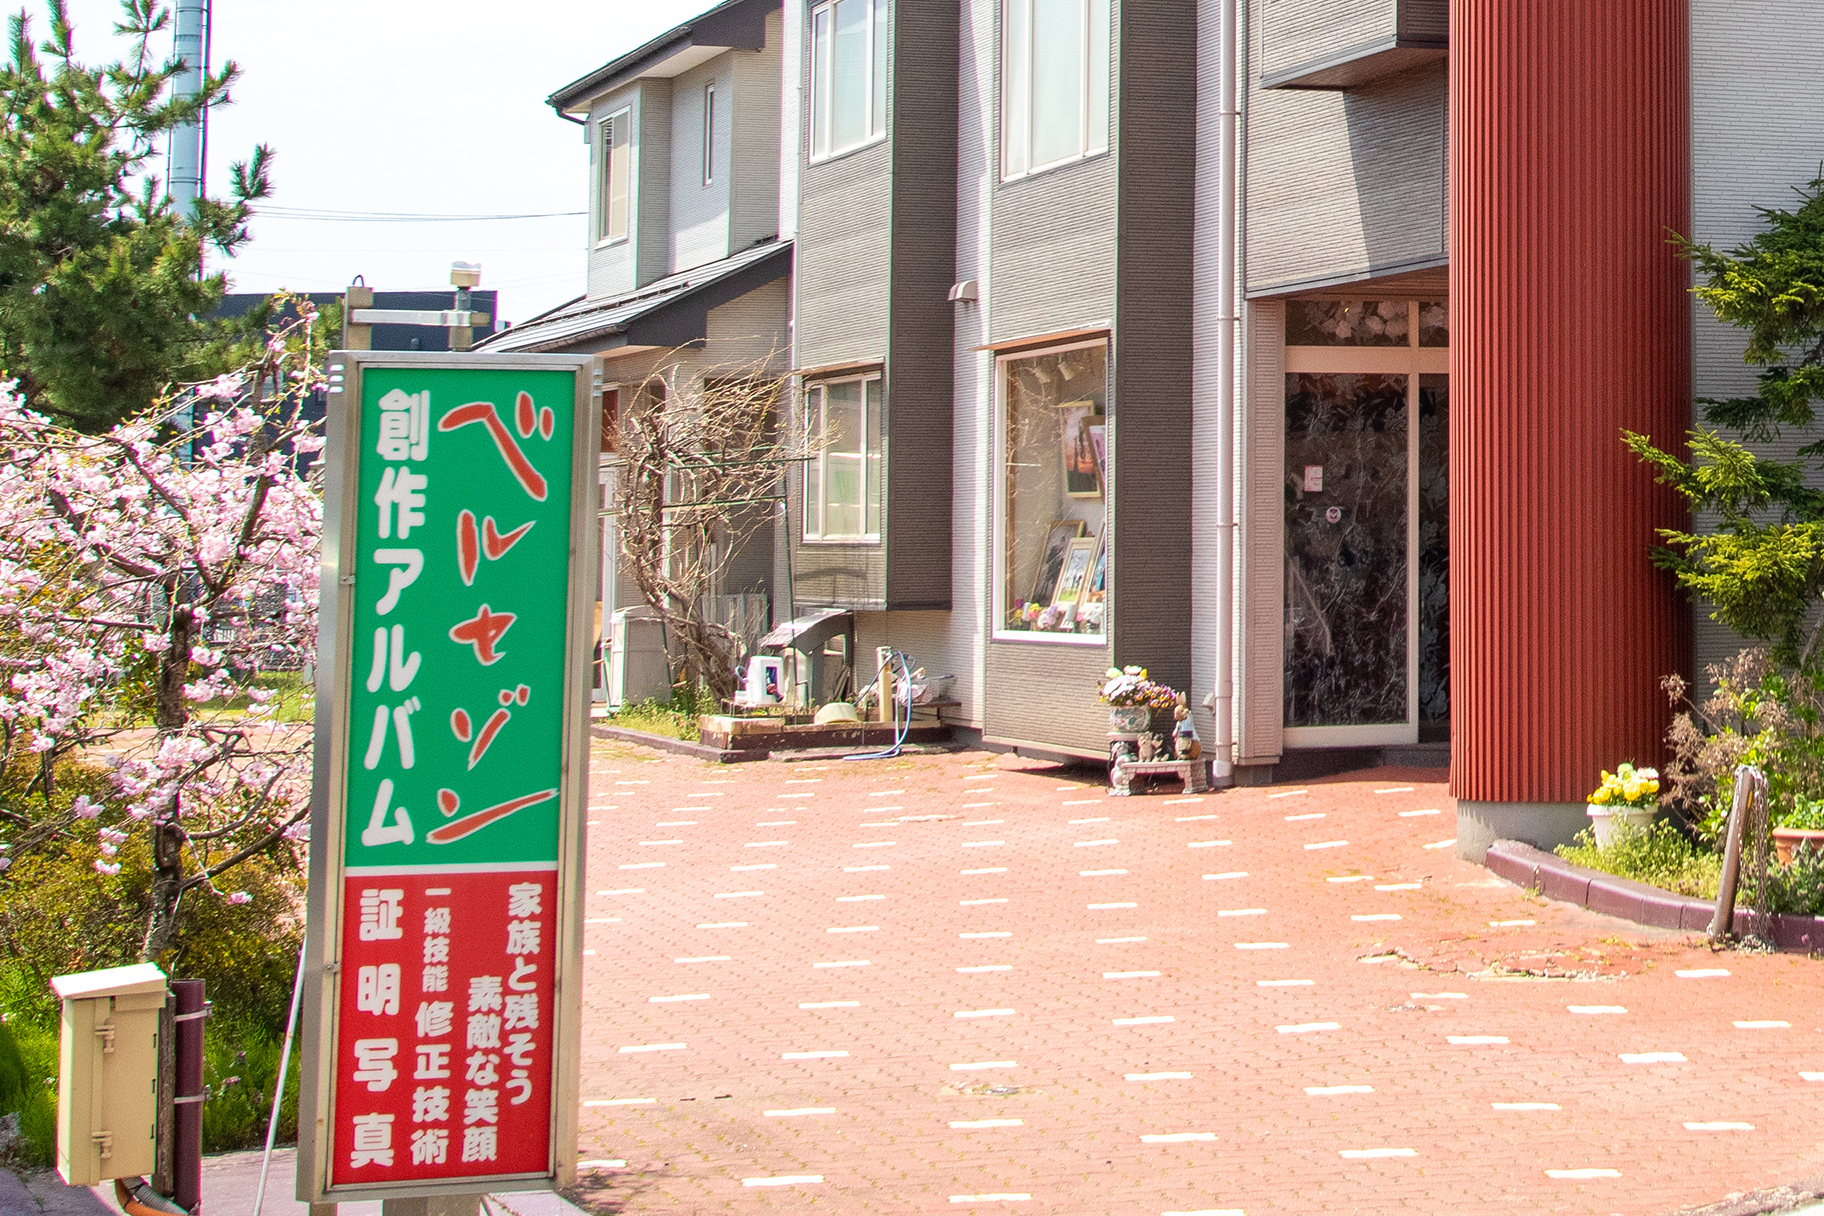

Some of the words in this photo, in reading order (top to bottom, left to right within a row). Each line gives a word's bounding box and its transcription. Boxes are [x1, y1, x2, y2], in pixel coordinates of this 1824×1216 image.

[361, 388, 431, 847] 創作アルバム
[425, 390, 559, 845] ベルセゾン
[350, 888, 405, 1169] 証明写真
[461, 975, 504, 1163] 素敵な笑顔
[503, 881, 543, 1106] 家族と残そう
